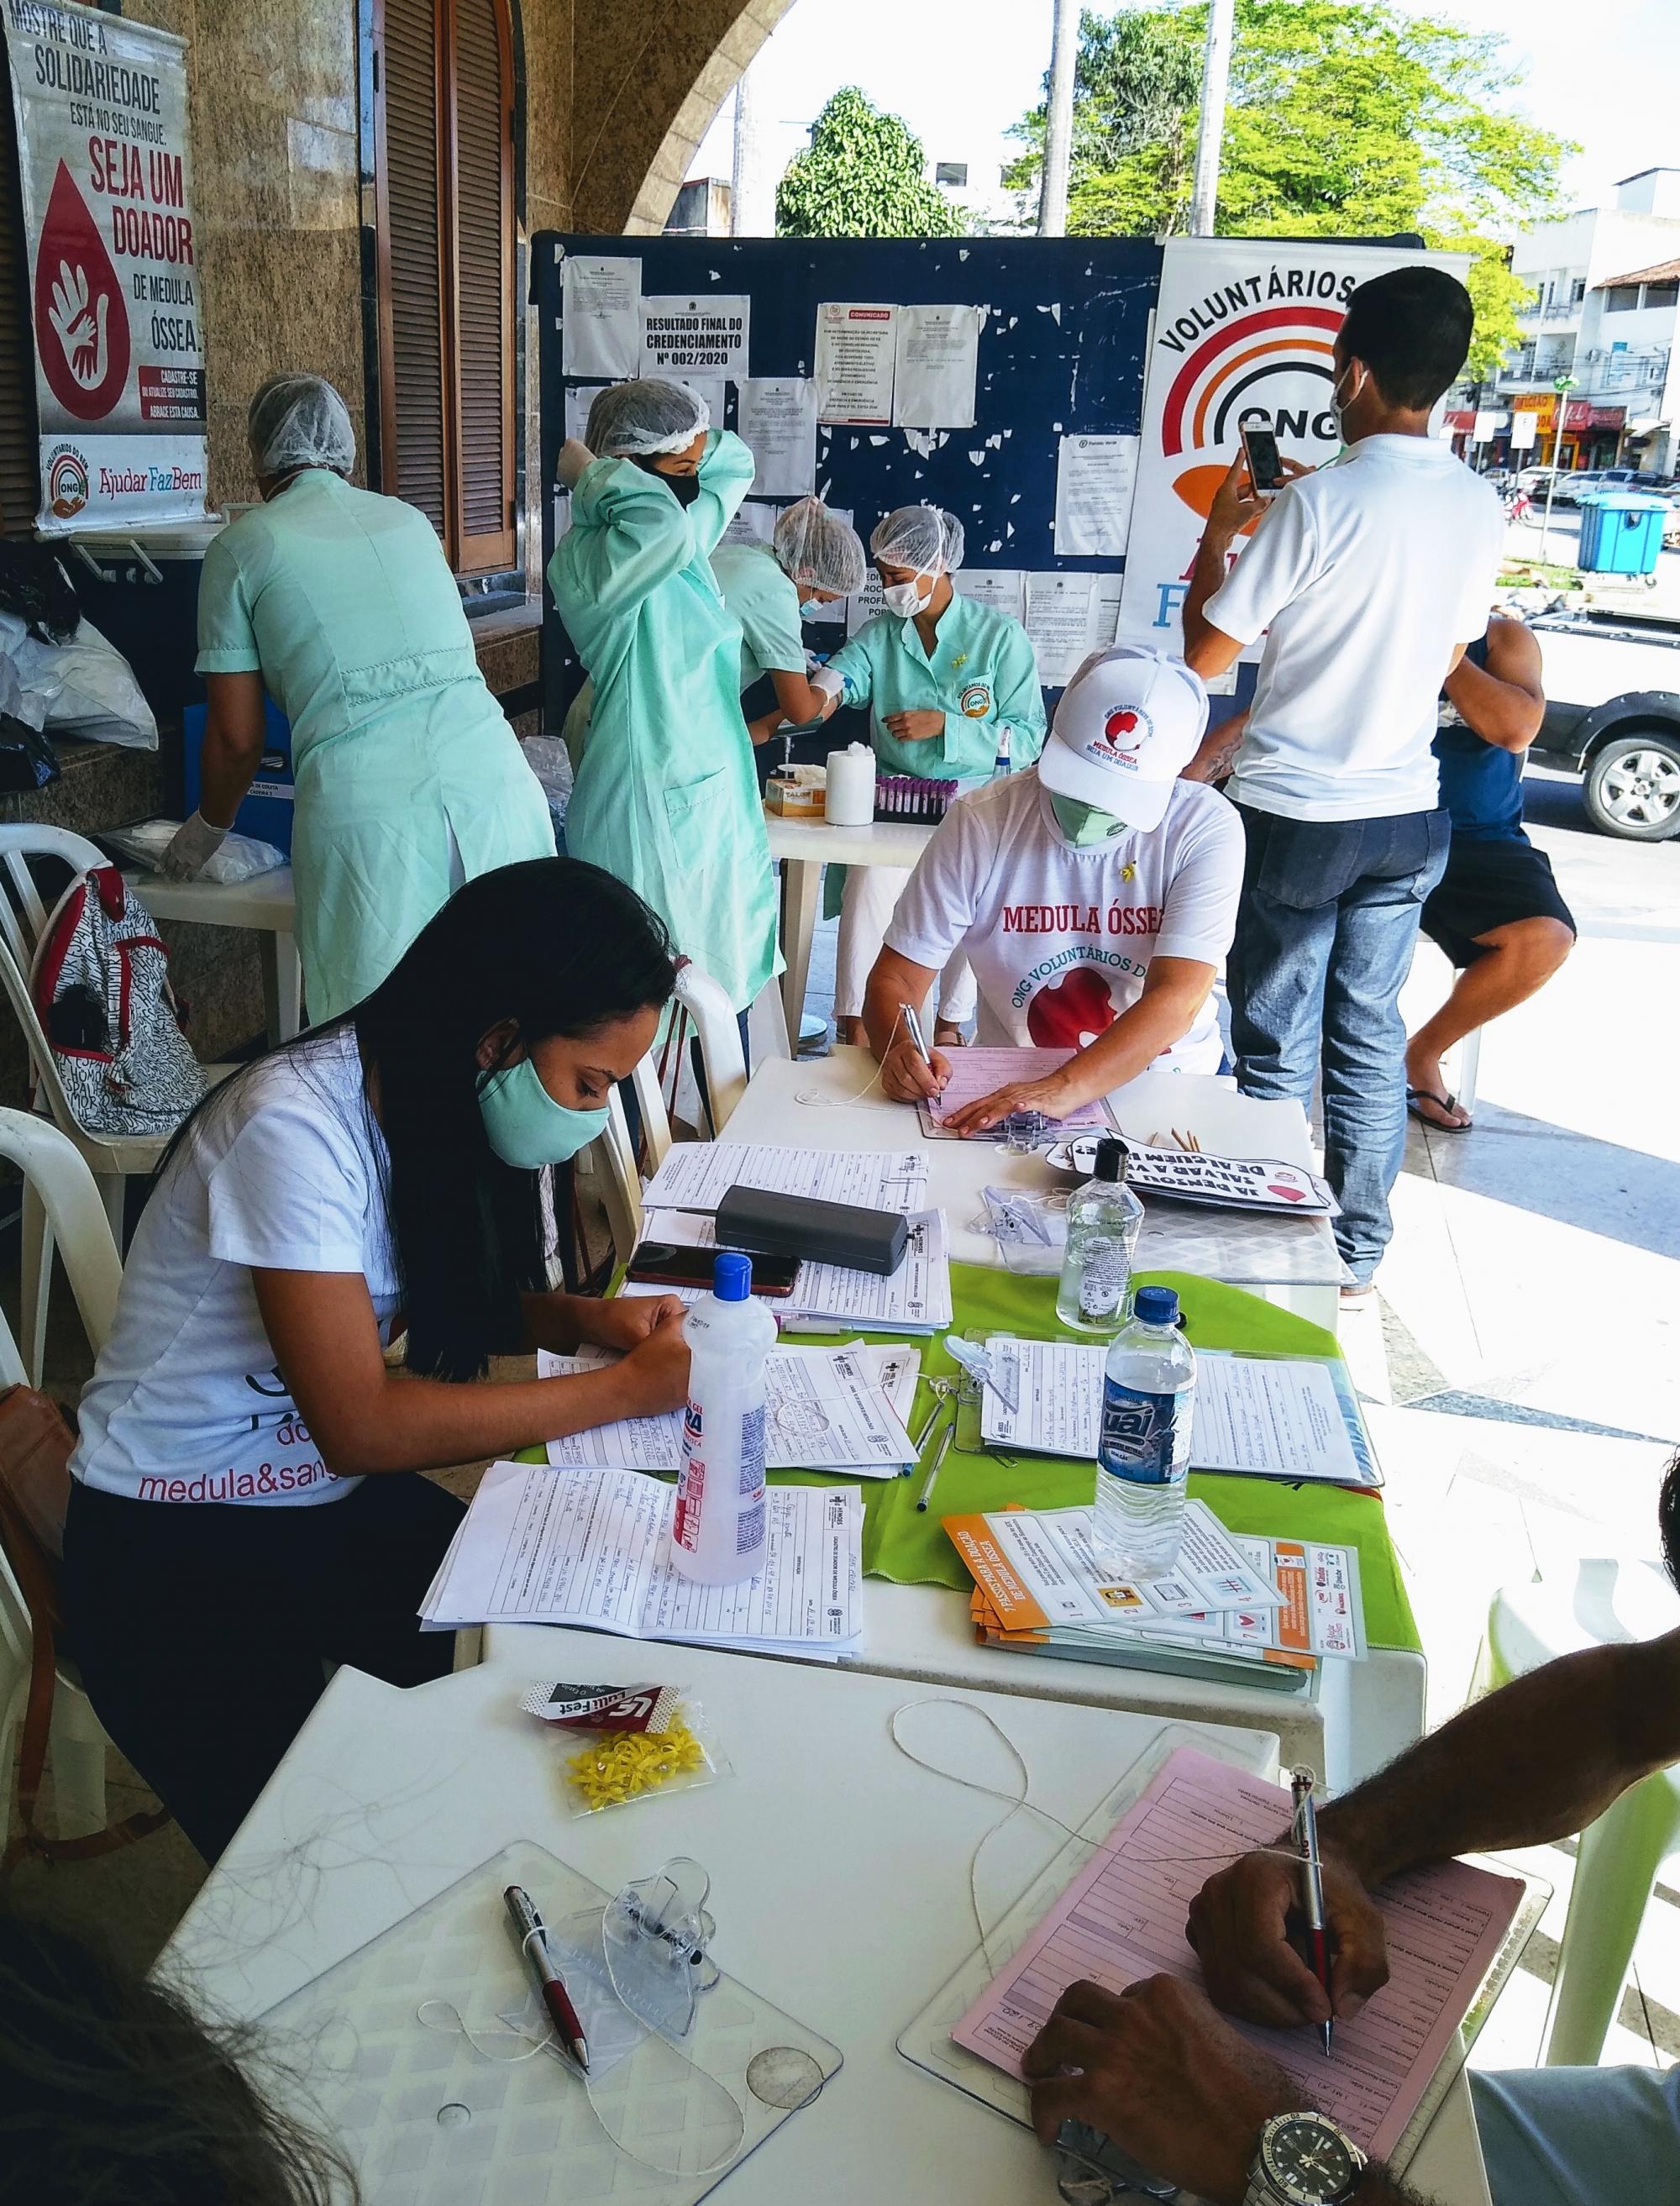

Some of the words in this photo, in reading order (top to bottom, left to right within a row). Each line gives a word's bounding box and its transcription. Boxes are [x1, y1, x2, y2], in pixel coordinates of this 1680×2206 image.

[9, 1, 66, 43] MOSTRE
[69, 15, 94, 52] QUE
[97, 24, 108, 55] A
[34, 44, 160, 115] SOLIDARIEDADE
[70, 102, 94, 127] ESTÁ
[96, 110, 110, 133] NO
[111, 112, 129, 137] SEU
[131, 118, 167, 146] SANGUE.
[88, 135, 145, 202] SEJA
[149, 150, 184, 208] UM
[112, 204, 194, 265] DOADOR
[134, 273, 148, 301] DE
[150, 276, 194, 307] MEDULA
[1158, 265, 1356, 354] VOLUNTÁRIOS
[151, 310, 202, 354] ÓSSEA.
[646, 318, 700, 331] RESULTADO
[701, 318, 727, 331] FINAL
[728, 318, 743, 331] DO
[646, 334, 742, 349] CREDENCIAMENTO
[657, 353, 669, 365] Nº
[672, 352, 728, 365] 002/2020
[161, 370, 198, 385] CADASTRE-SE
[150, 406, 169, 418] ABRACE
[170, 406, 181, 418] ESTA
[60, 483, 78, 492] ONG
[99, 468, 148, 501] Ajudar
[1093, 740, 1117, 757] MEDULA
[1101, 753, 1113, 762] UM
[1003, 905, 1101, 934] MEDULA
[1011, 979, 1032, 1009] ONG
[1028, 944, 1131, 981] VOLUNTÁRIOS
[1134, 964, 1147, 979] D
[1152, 1163, 1167, 1173] A
[1173, 1166, 1255, 1185] SALVAR
[1236, 1163, 1265, 1176] DE
[1142, 1174, 1231, 1192] PENSOU
[693, 1403, 703, 1415] GEL
[559, 1701, 590, 1715] Fest
[593, 1692, 626, 1710] Lulli
[1333, 2128, 1343, 2136] 30
[1278, 2178, 1288, 2188] 60
